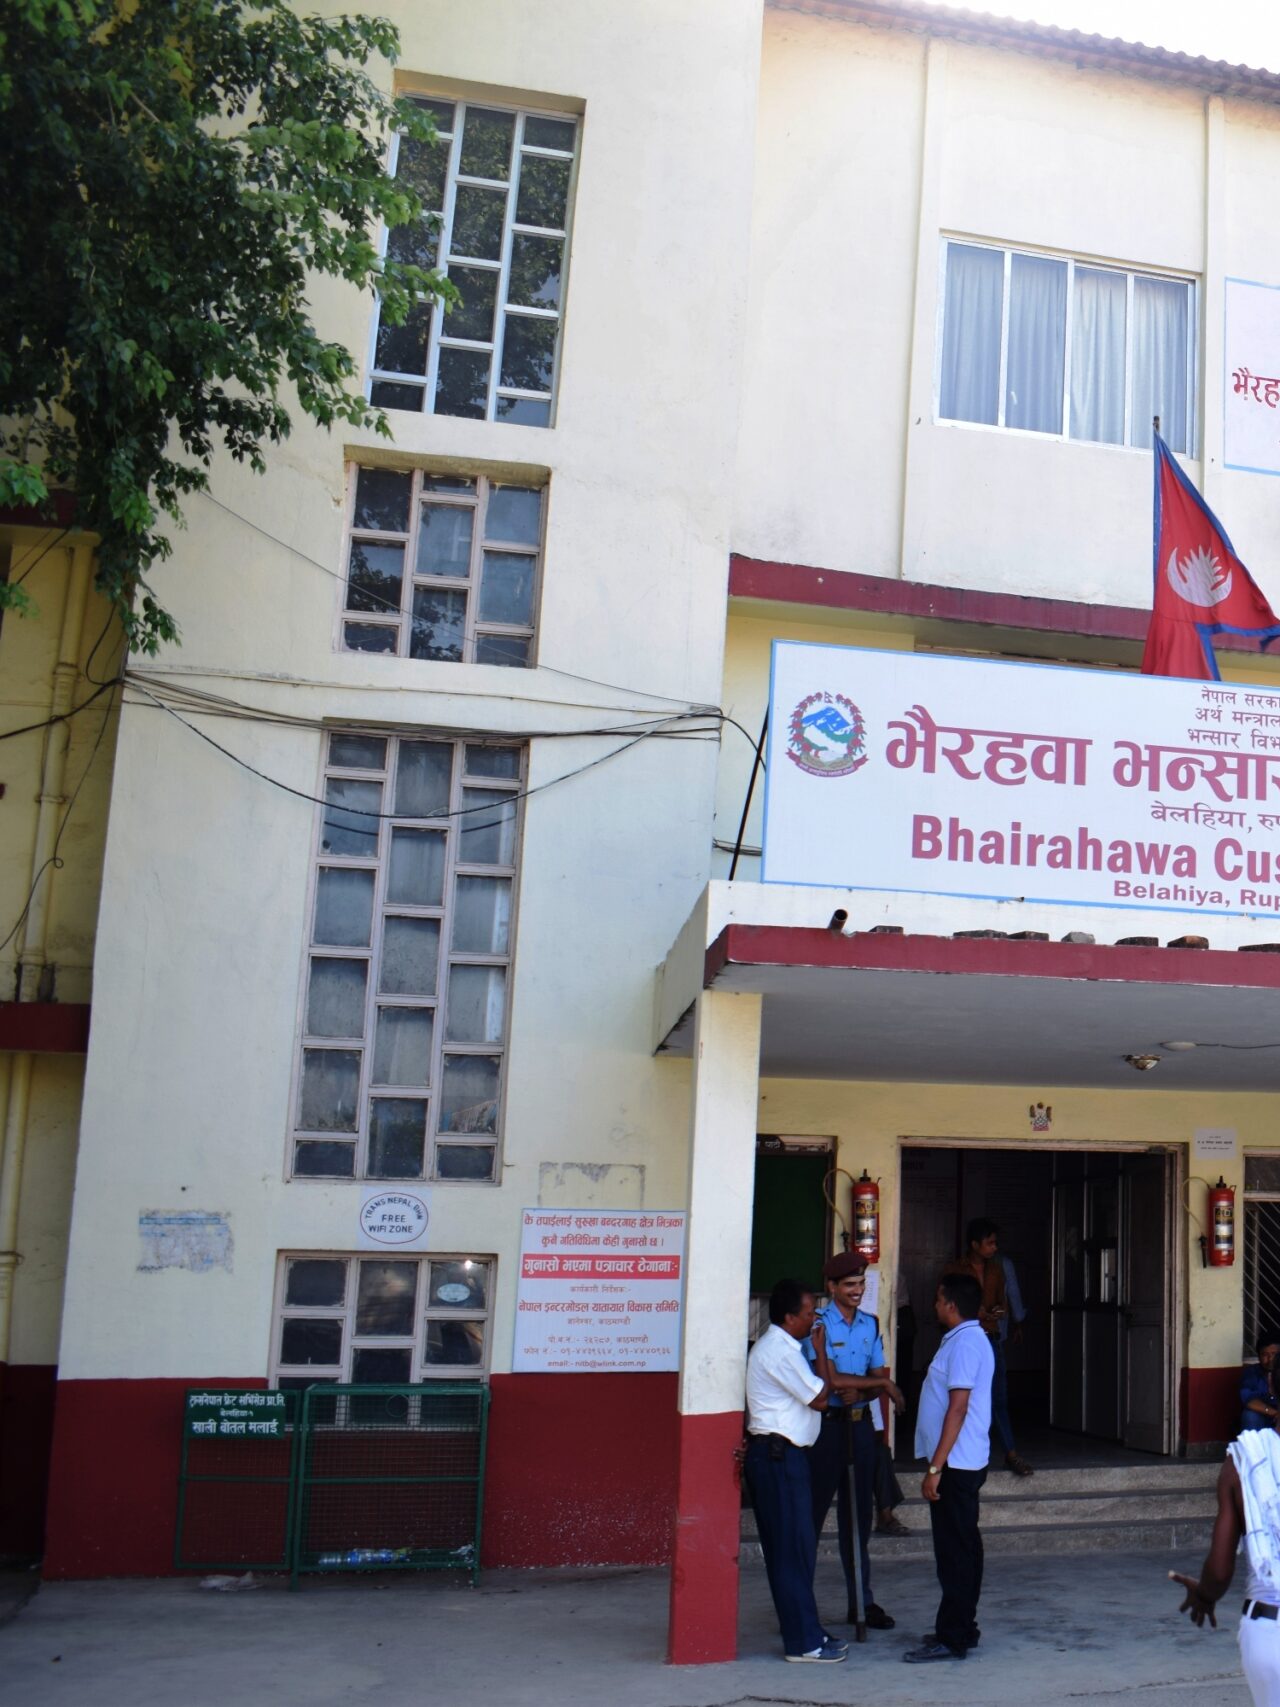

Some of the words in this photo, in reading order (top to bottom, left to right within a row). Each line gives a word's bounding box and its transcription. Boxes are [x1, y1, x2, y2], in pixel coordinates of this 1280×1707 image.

[1201, 685, 1236, 705] नेपाल
[1195, 705, 1222, 722] अर्थ
[885, 704, 1092, 786] भैरहवा
[1187, 728, 1241, 749] भन्सार
[1150, 800, 1253, 833] बेलहिया,
[912, 814, 1196, 879] Bhairahawa
[1113, 880, 1231, 908] Belahiya,
[365, 1199, 386, 1219] TRANS
[387, 1197, 412, 1208] NEPAL
[381, 1214, 406, 1223] FREE
[525, 1213, 533, 1225] के
[368, 1225, 387, 1233] WIFI
[389, 1225, 413, 1234] ZONE
[524, 1256, 559, 1275] गुनासो
[562, 1258, 592, 1272] भएमा
[518, 1300, 541, 1312] नेपाल
